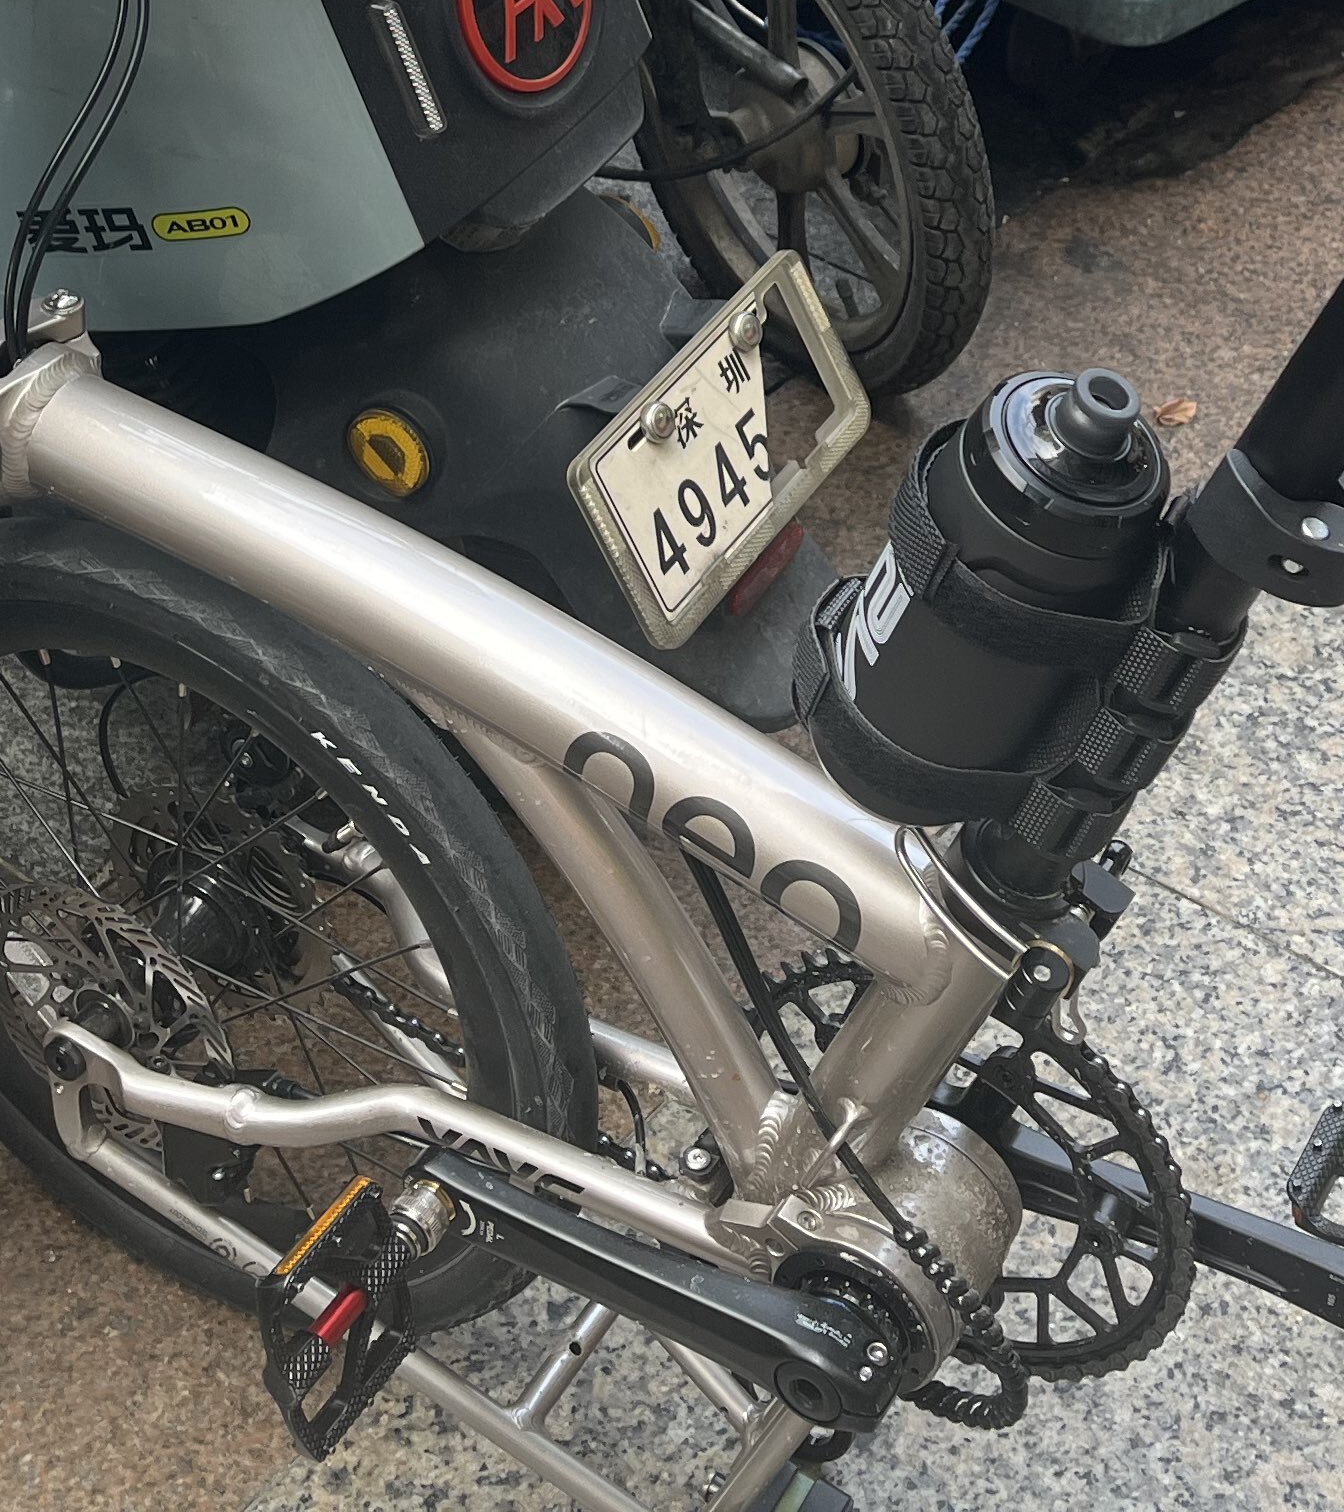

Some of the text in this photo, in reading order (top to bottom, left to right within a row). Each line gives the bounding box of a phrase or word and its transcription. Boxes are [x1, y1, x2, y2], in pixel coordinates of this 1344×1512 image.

[16, 206, 153, 253] 爱玛
[167, 214, 239, 234] AB01
[674, 352, 752, 449] 深圳
[310, 731, 432, 865] KENDA
